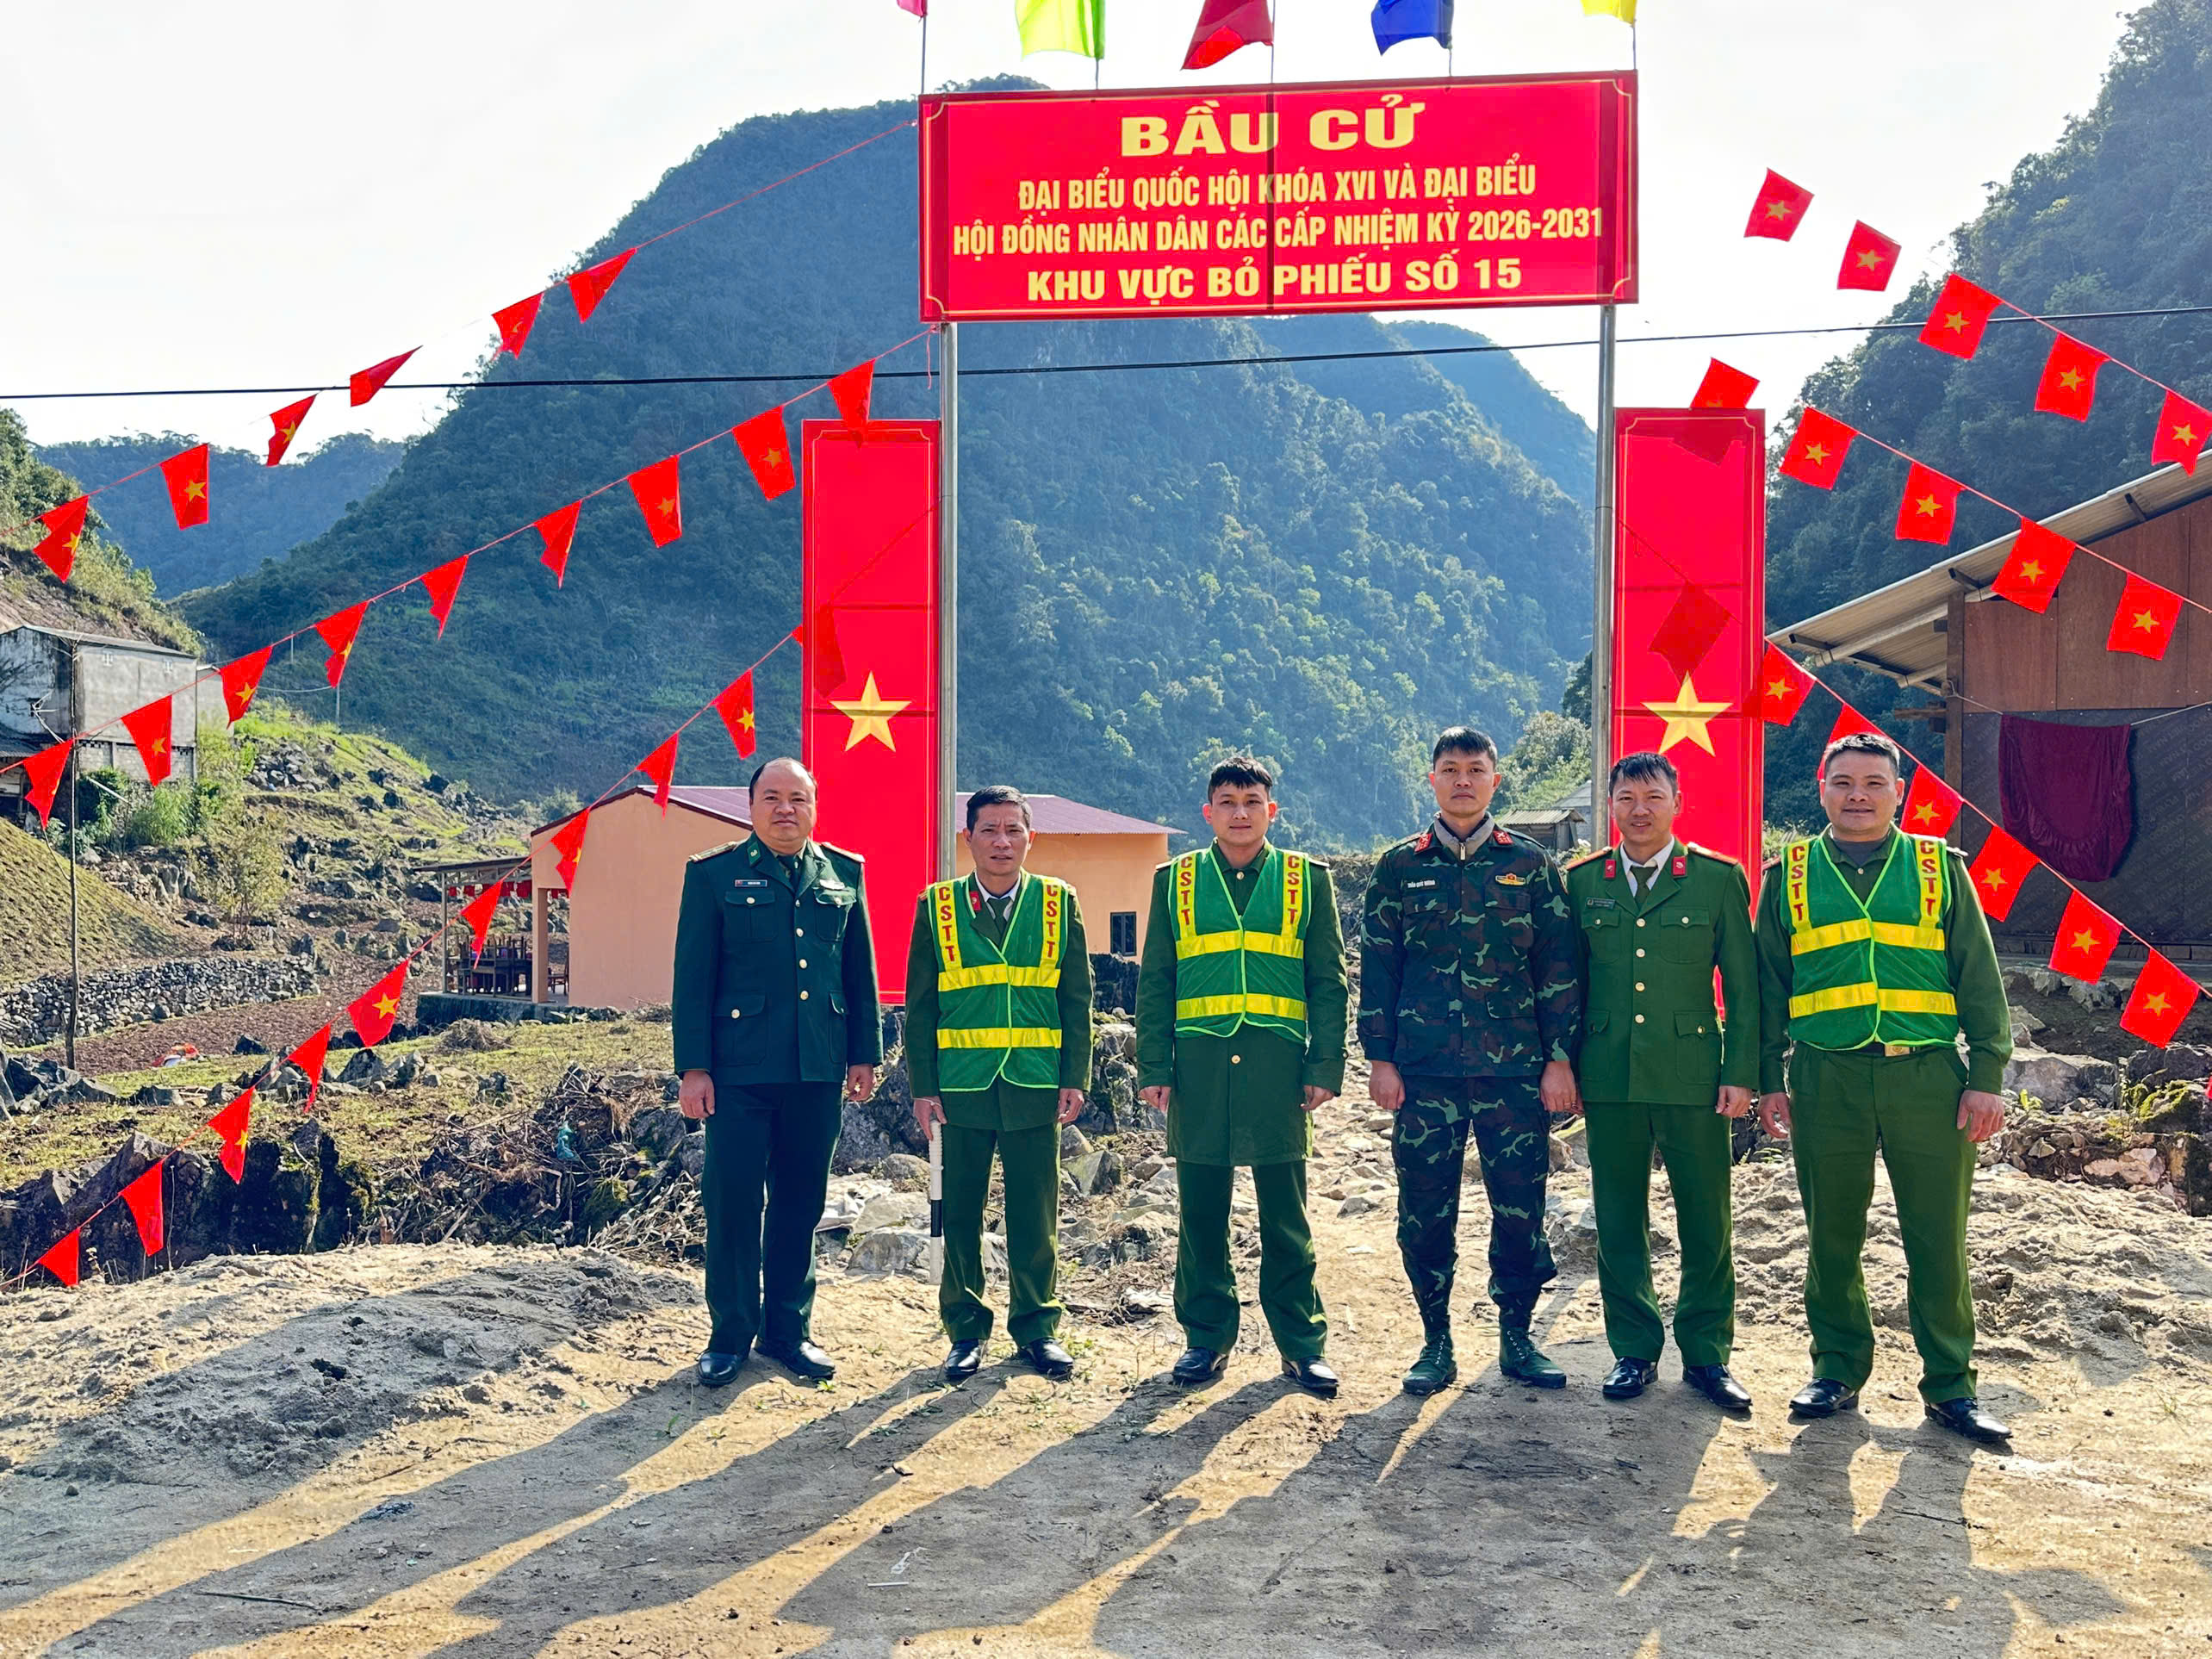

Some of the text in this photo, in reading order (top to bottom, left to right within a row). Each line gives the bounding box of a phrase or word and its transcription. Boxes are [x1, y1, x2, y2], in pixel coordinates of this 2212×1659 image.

[1122, 94, 1425, 156] BẦU CỬ
[1019, 153, 1535, 217] ĐẠI BIỂU QUỐC HỘI KHÓA XVI VÀ ĐẠI BIỂU
[954, 206, 1601, 261] HỘI ĐỒNG NHÂN DÂN CÁC CẤP NHIỆM KỲ 2026-2031
[1028, 249, 1521, 305] KHU VỰC BỎ PHIẾU SỐ 15
[1180, 856, 1192, 925] CSTT
[1288, 855, 1299, 923] CSTT
[1792, 846, 1805, 921] CSTT
[1920, 841, 1936, 916] CSTT
[939, 887, 954, 961] CSTT
[1046, 885, 1058, 958] CSTT
